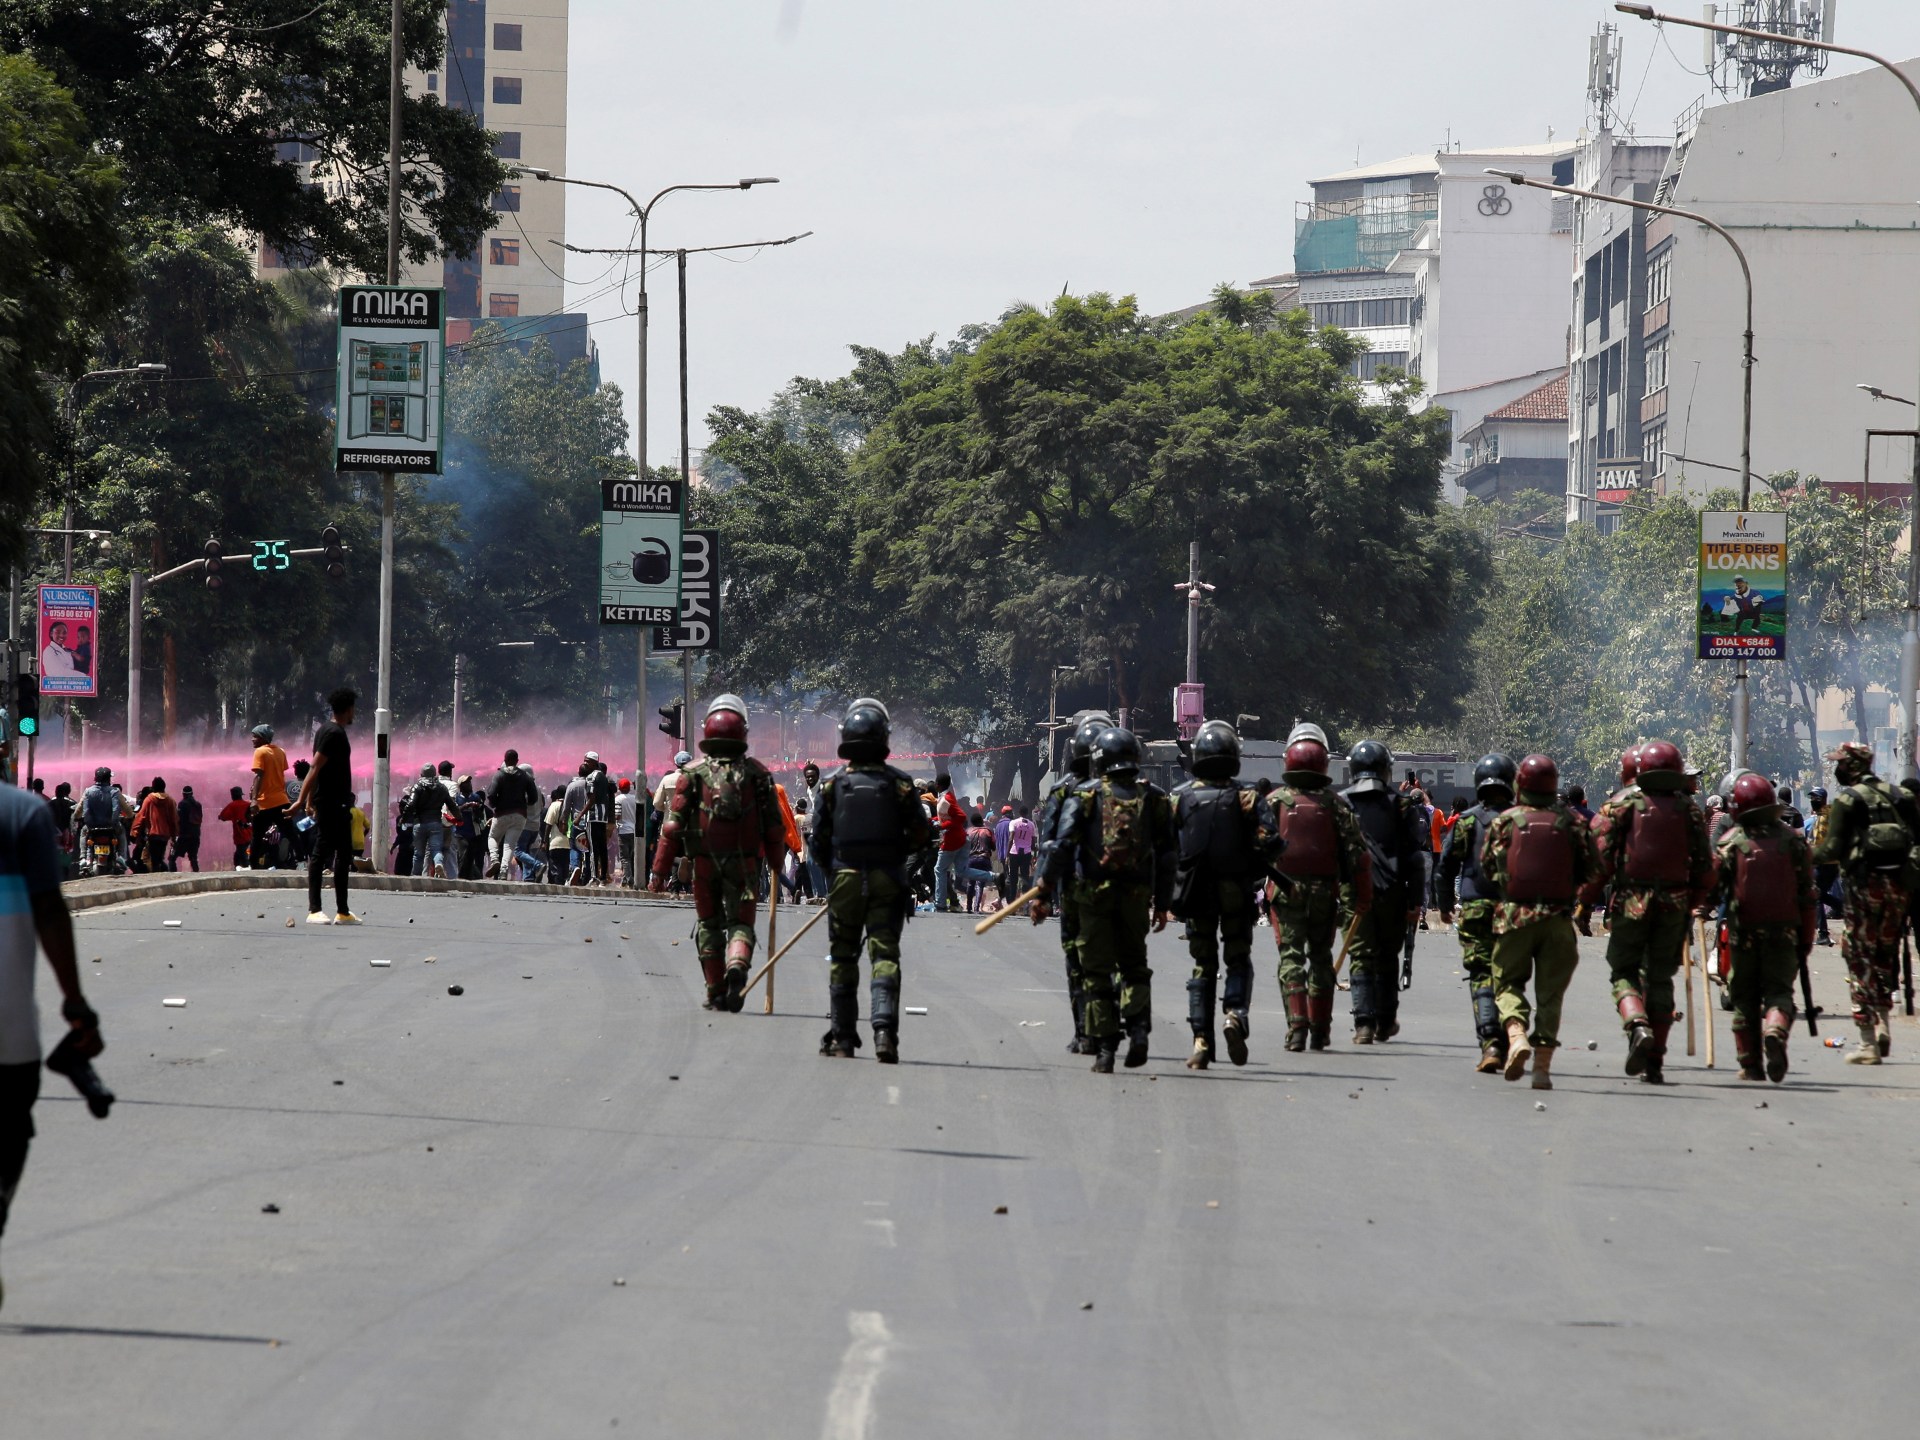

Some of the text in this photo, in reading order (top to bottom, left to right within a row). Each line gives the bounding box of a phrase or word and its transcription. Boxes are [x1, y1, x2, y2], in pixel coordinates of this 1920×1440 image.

[353, 291, 428, 315] MIKA
[370, 317, 406, 325] Wonderful
[343, 453, 431, 465] REFRIGERATORS
[1596, 470, 1638, 489] JAVA
[612, 483, 672, 503] MIKA
[655, 503, 671, 511] World
[253, 541, 289, 570] 25
[1706, 544, 1779, 554] TITLE DEED
[1707, 553, 1780, 571] LOANS
[677, 534, 711, 647] MIKA
[605, 606, 672, 622] KETTLES
[662, 627, 672, 647] orld
[1715, 637, 1740, 646] DIAL
[1709, 648, 1777, 656] 0709 147 000
